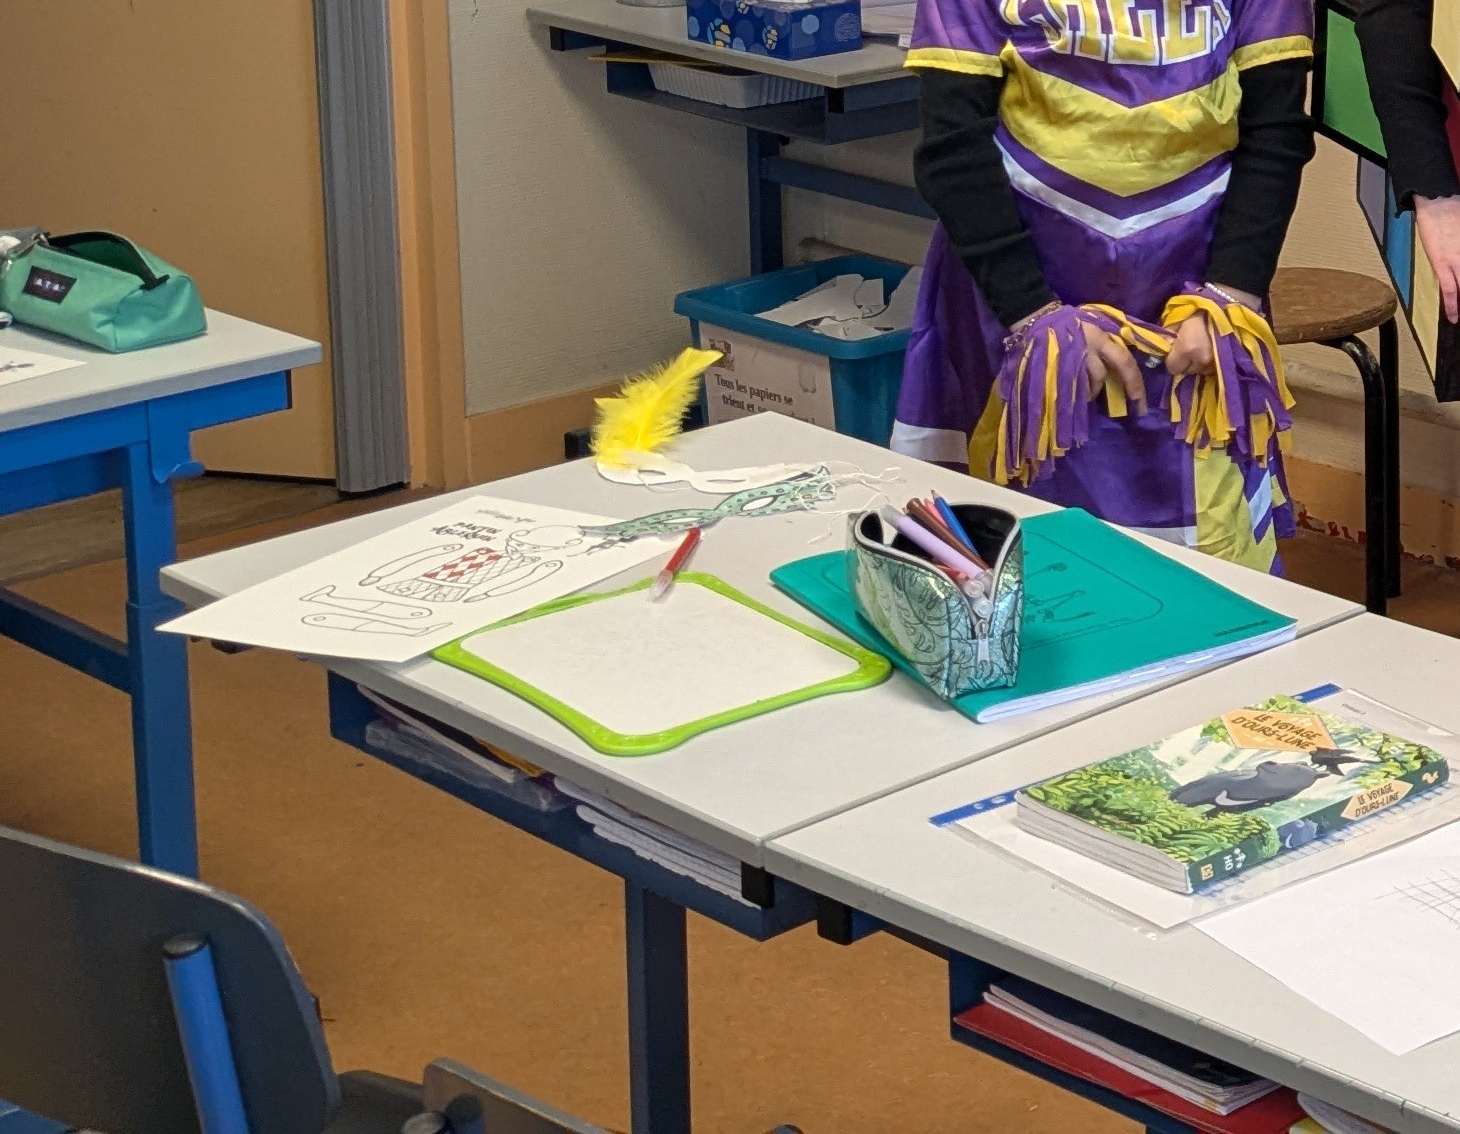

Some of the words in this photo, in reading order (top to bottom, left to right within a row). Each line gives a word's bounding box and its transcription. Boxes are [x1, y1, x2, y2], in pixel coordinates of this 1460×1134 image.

[714, 373, 735, 391] Tous
[736, 379, 748, 393] les
[750, 385, 781, 403] papiers
[784, 396, 793, 405] se
[1231, 717, 1317, 749] D'OURS-LUNE
[1255, 714, 1273, 722] LE
[1272, 720, 1322, 740] VOYAGE
[1358, 795, 1366, 805] LE
[1367, 783, 1394, 800] VOYAGE
